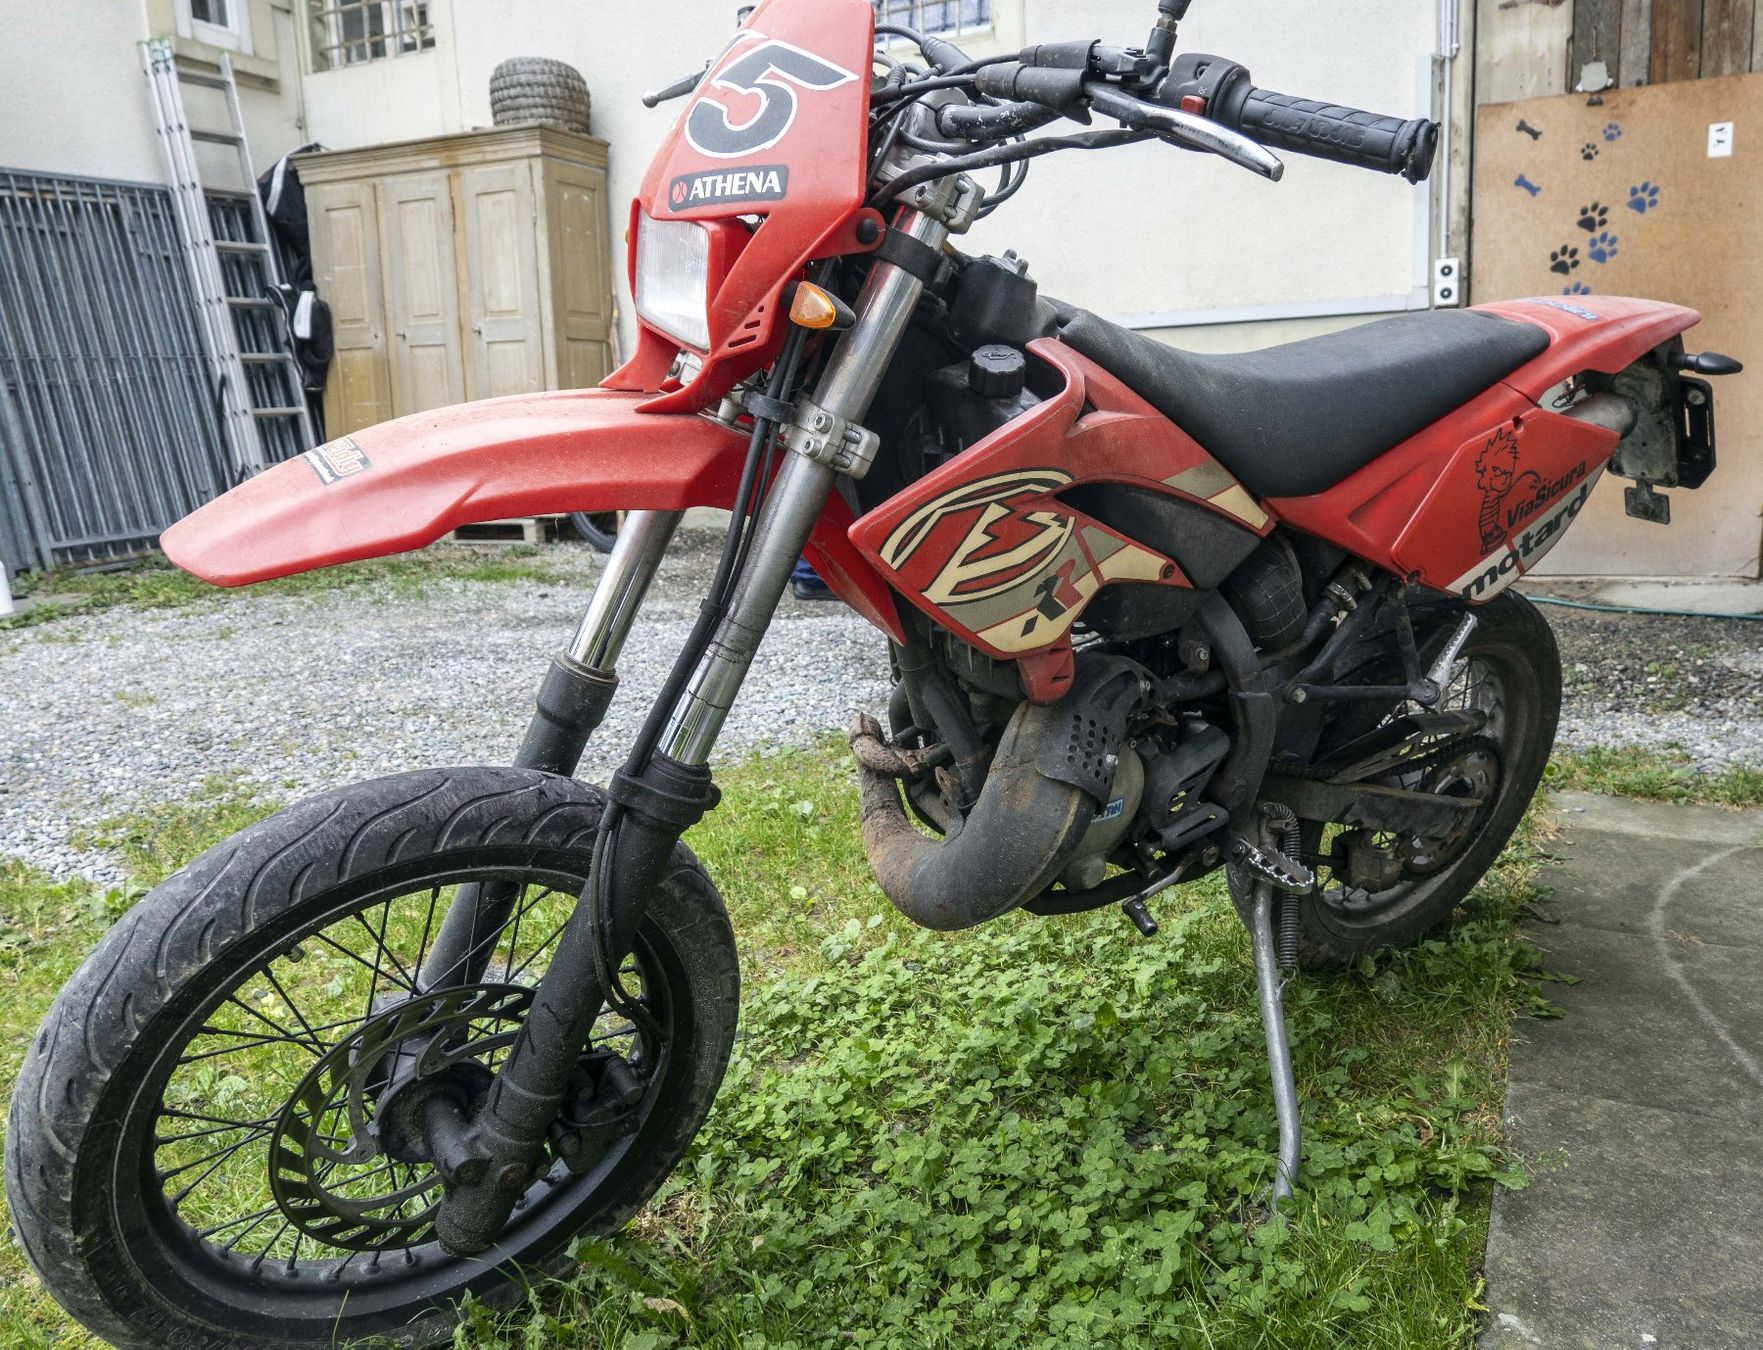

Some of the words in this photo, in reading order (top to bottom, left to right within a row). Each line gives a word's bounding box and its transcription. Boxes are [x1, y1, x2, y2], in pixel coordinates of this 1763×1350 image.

[685, 39, 860, 158] 5
[689, 171, 781, 200] ATHENA
[1506, 459, 1587, 529] ViaSicura
[1461, 483, 1588, 600] motard
